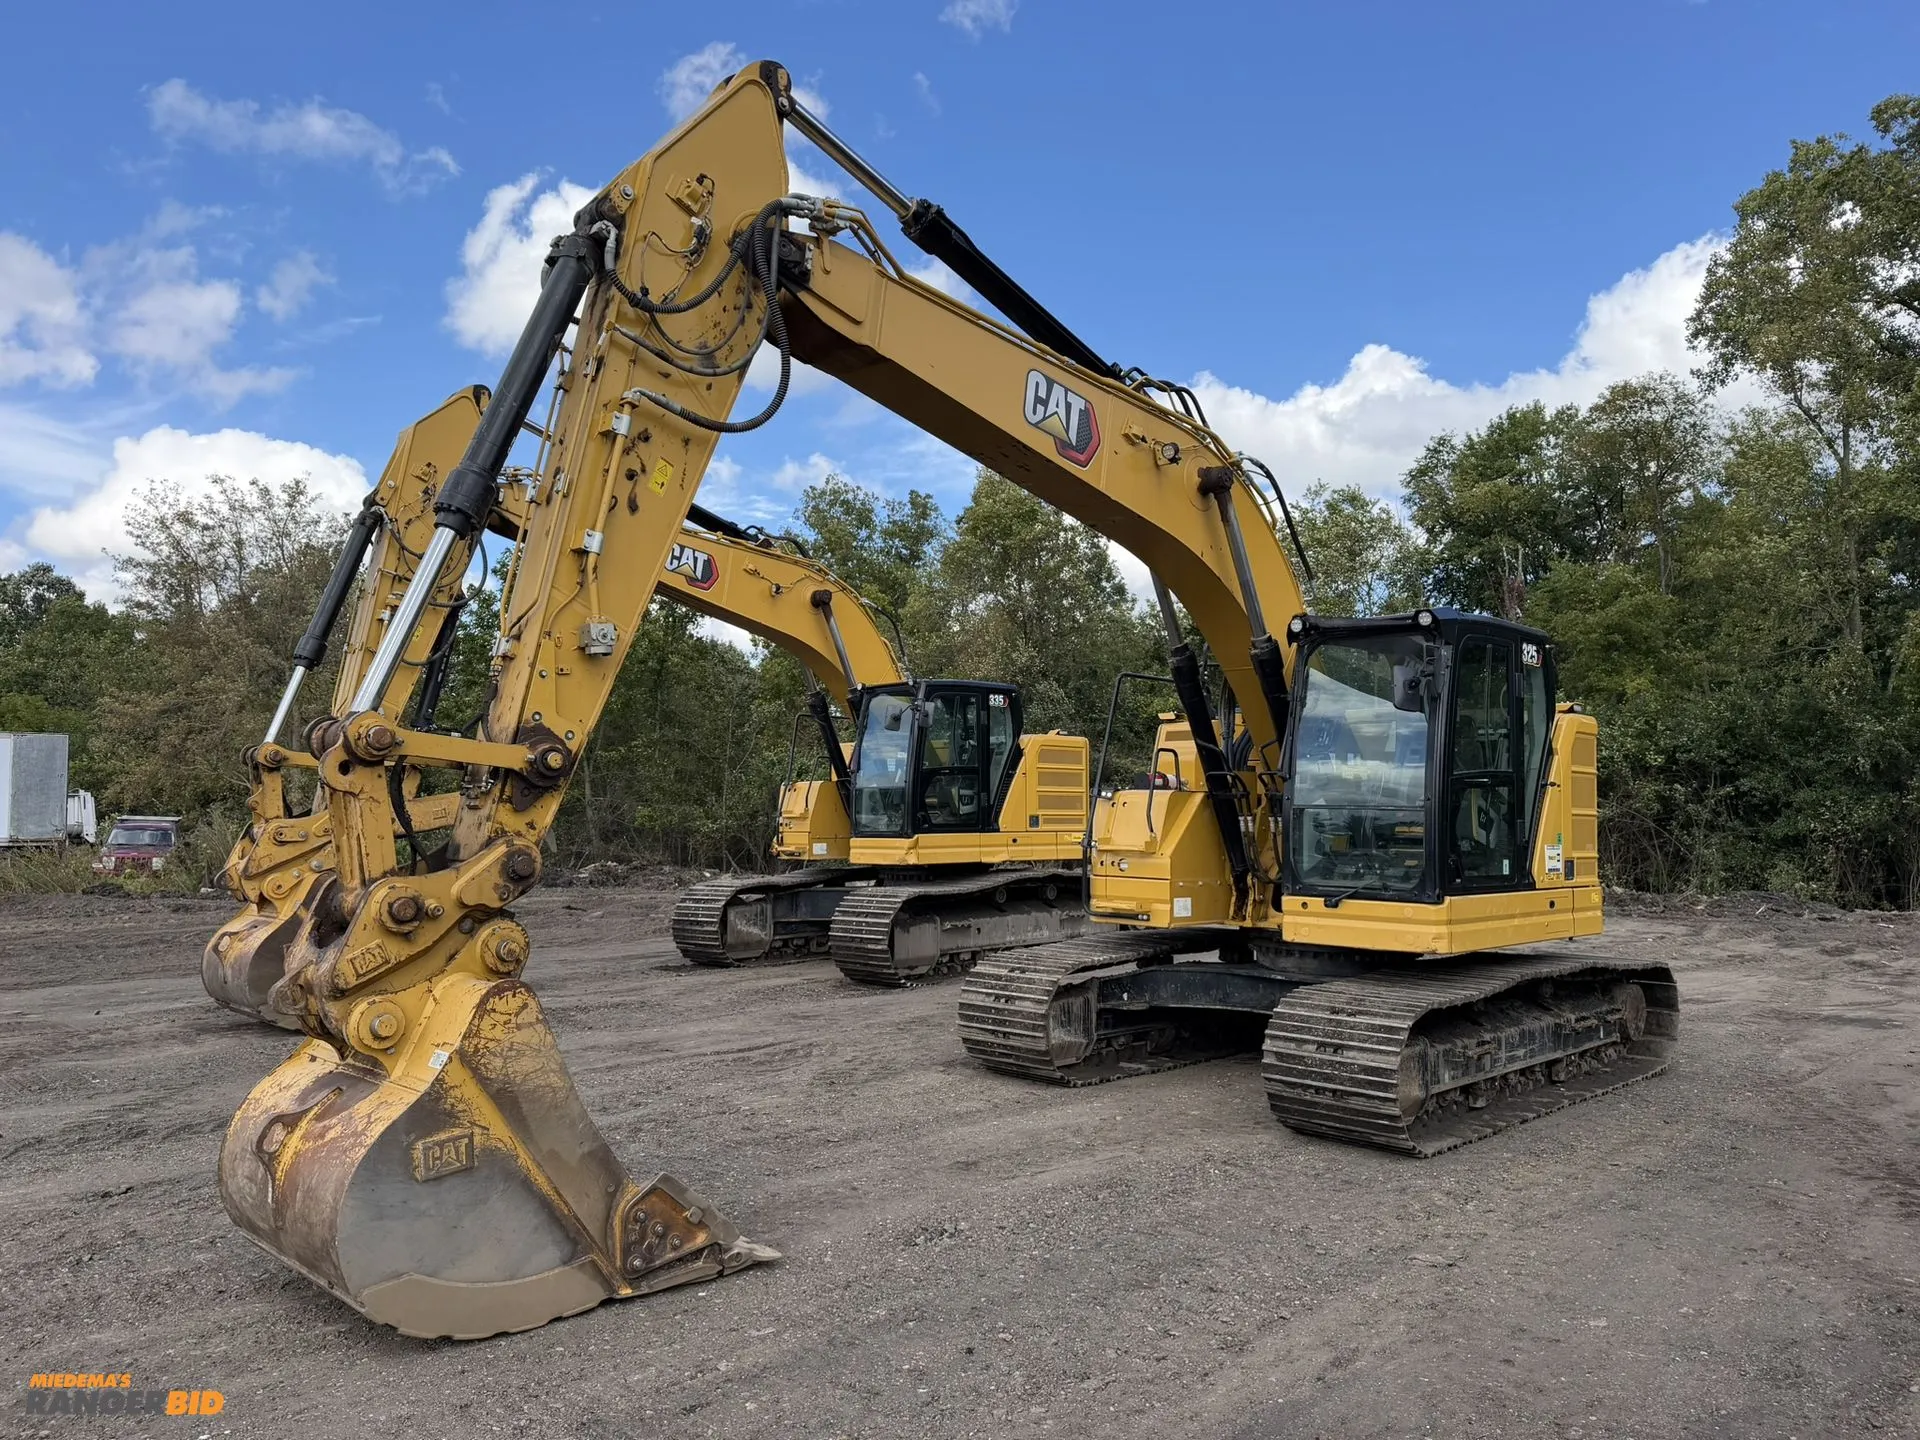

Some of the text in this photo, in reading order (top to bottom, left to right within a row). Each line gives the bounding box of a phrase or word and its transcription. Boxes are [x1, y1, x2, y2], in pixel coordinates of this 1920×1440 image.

[1025, 371, 1085, 446] CAT
[665, 543, 708, 580] CAT
[1522, 643, 1537, 663] 325
[989, 694, 1004, 706] 335
[427, 1138, 468, 1170] CAT
